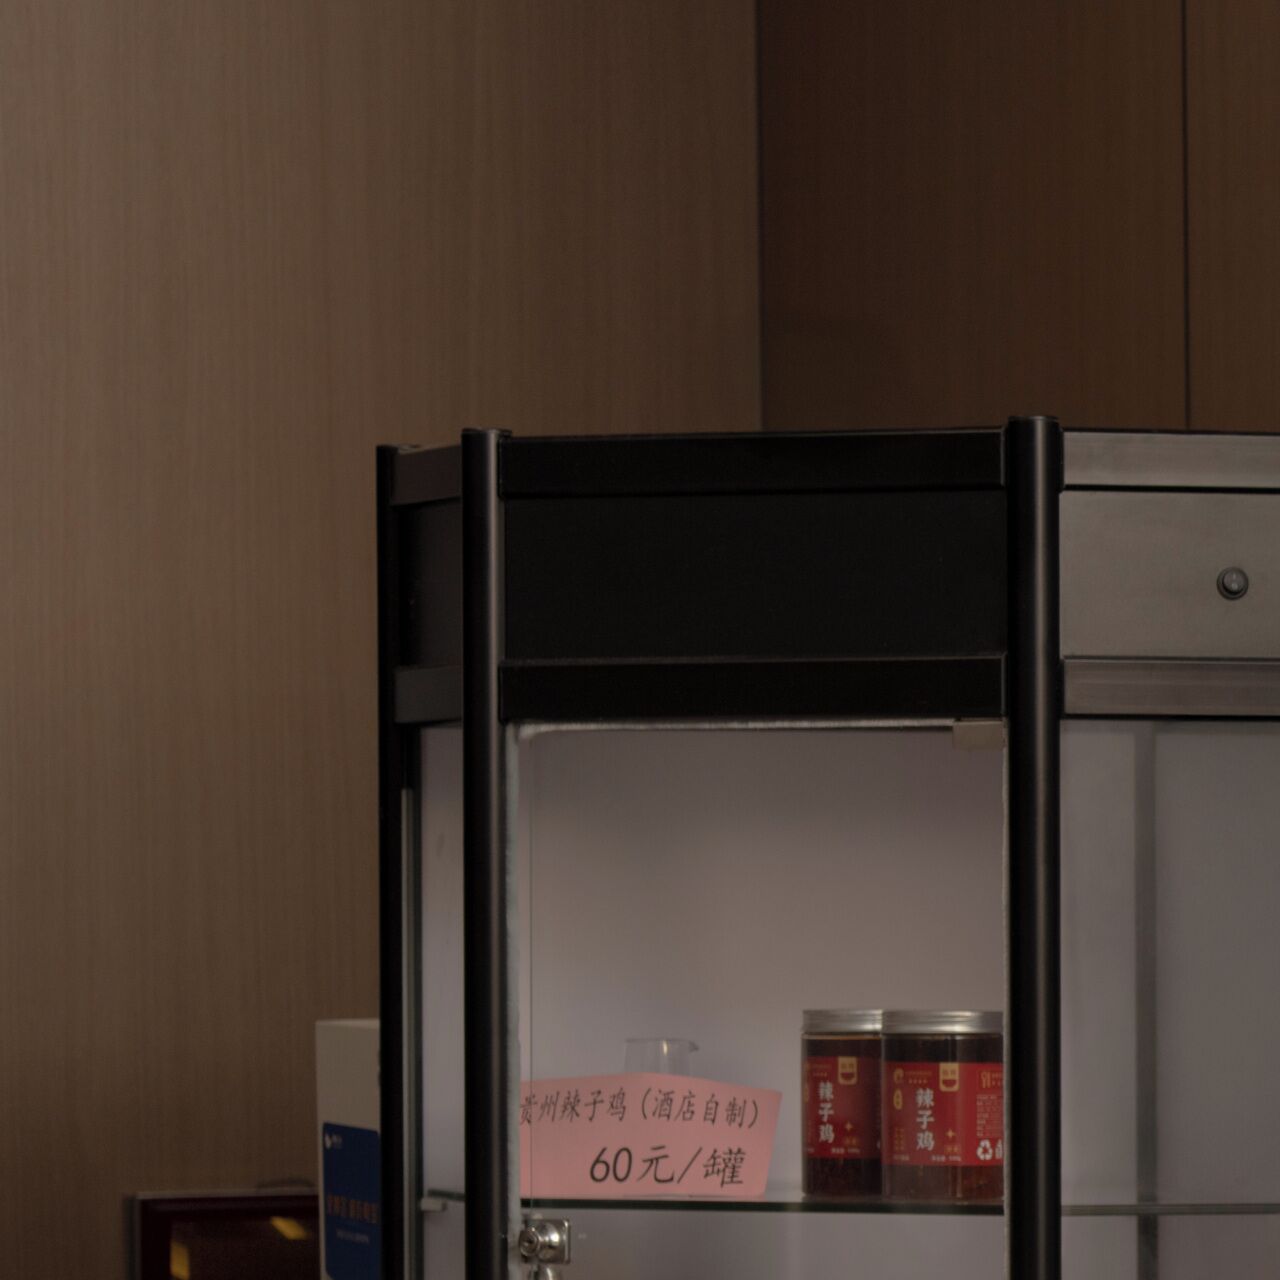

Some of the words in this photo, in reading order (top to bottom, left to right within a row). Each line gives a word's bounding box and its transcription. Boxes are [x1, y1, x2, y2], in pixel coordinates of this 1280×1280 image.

[818, 1080, 835, 1144] 辣子鸡
[915, 1088, 936, 1151] 辣子鸡
[589, 1145, 746, 1189] 60元/罐
